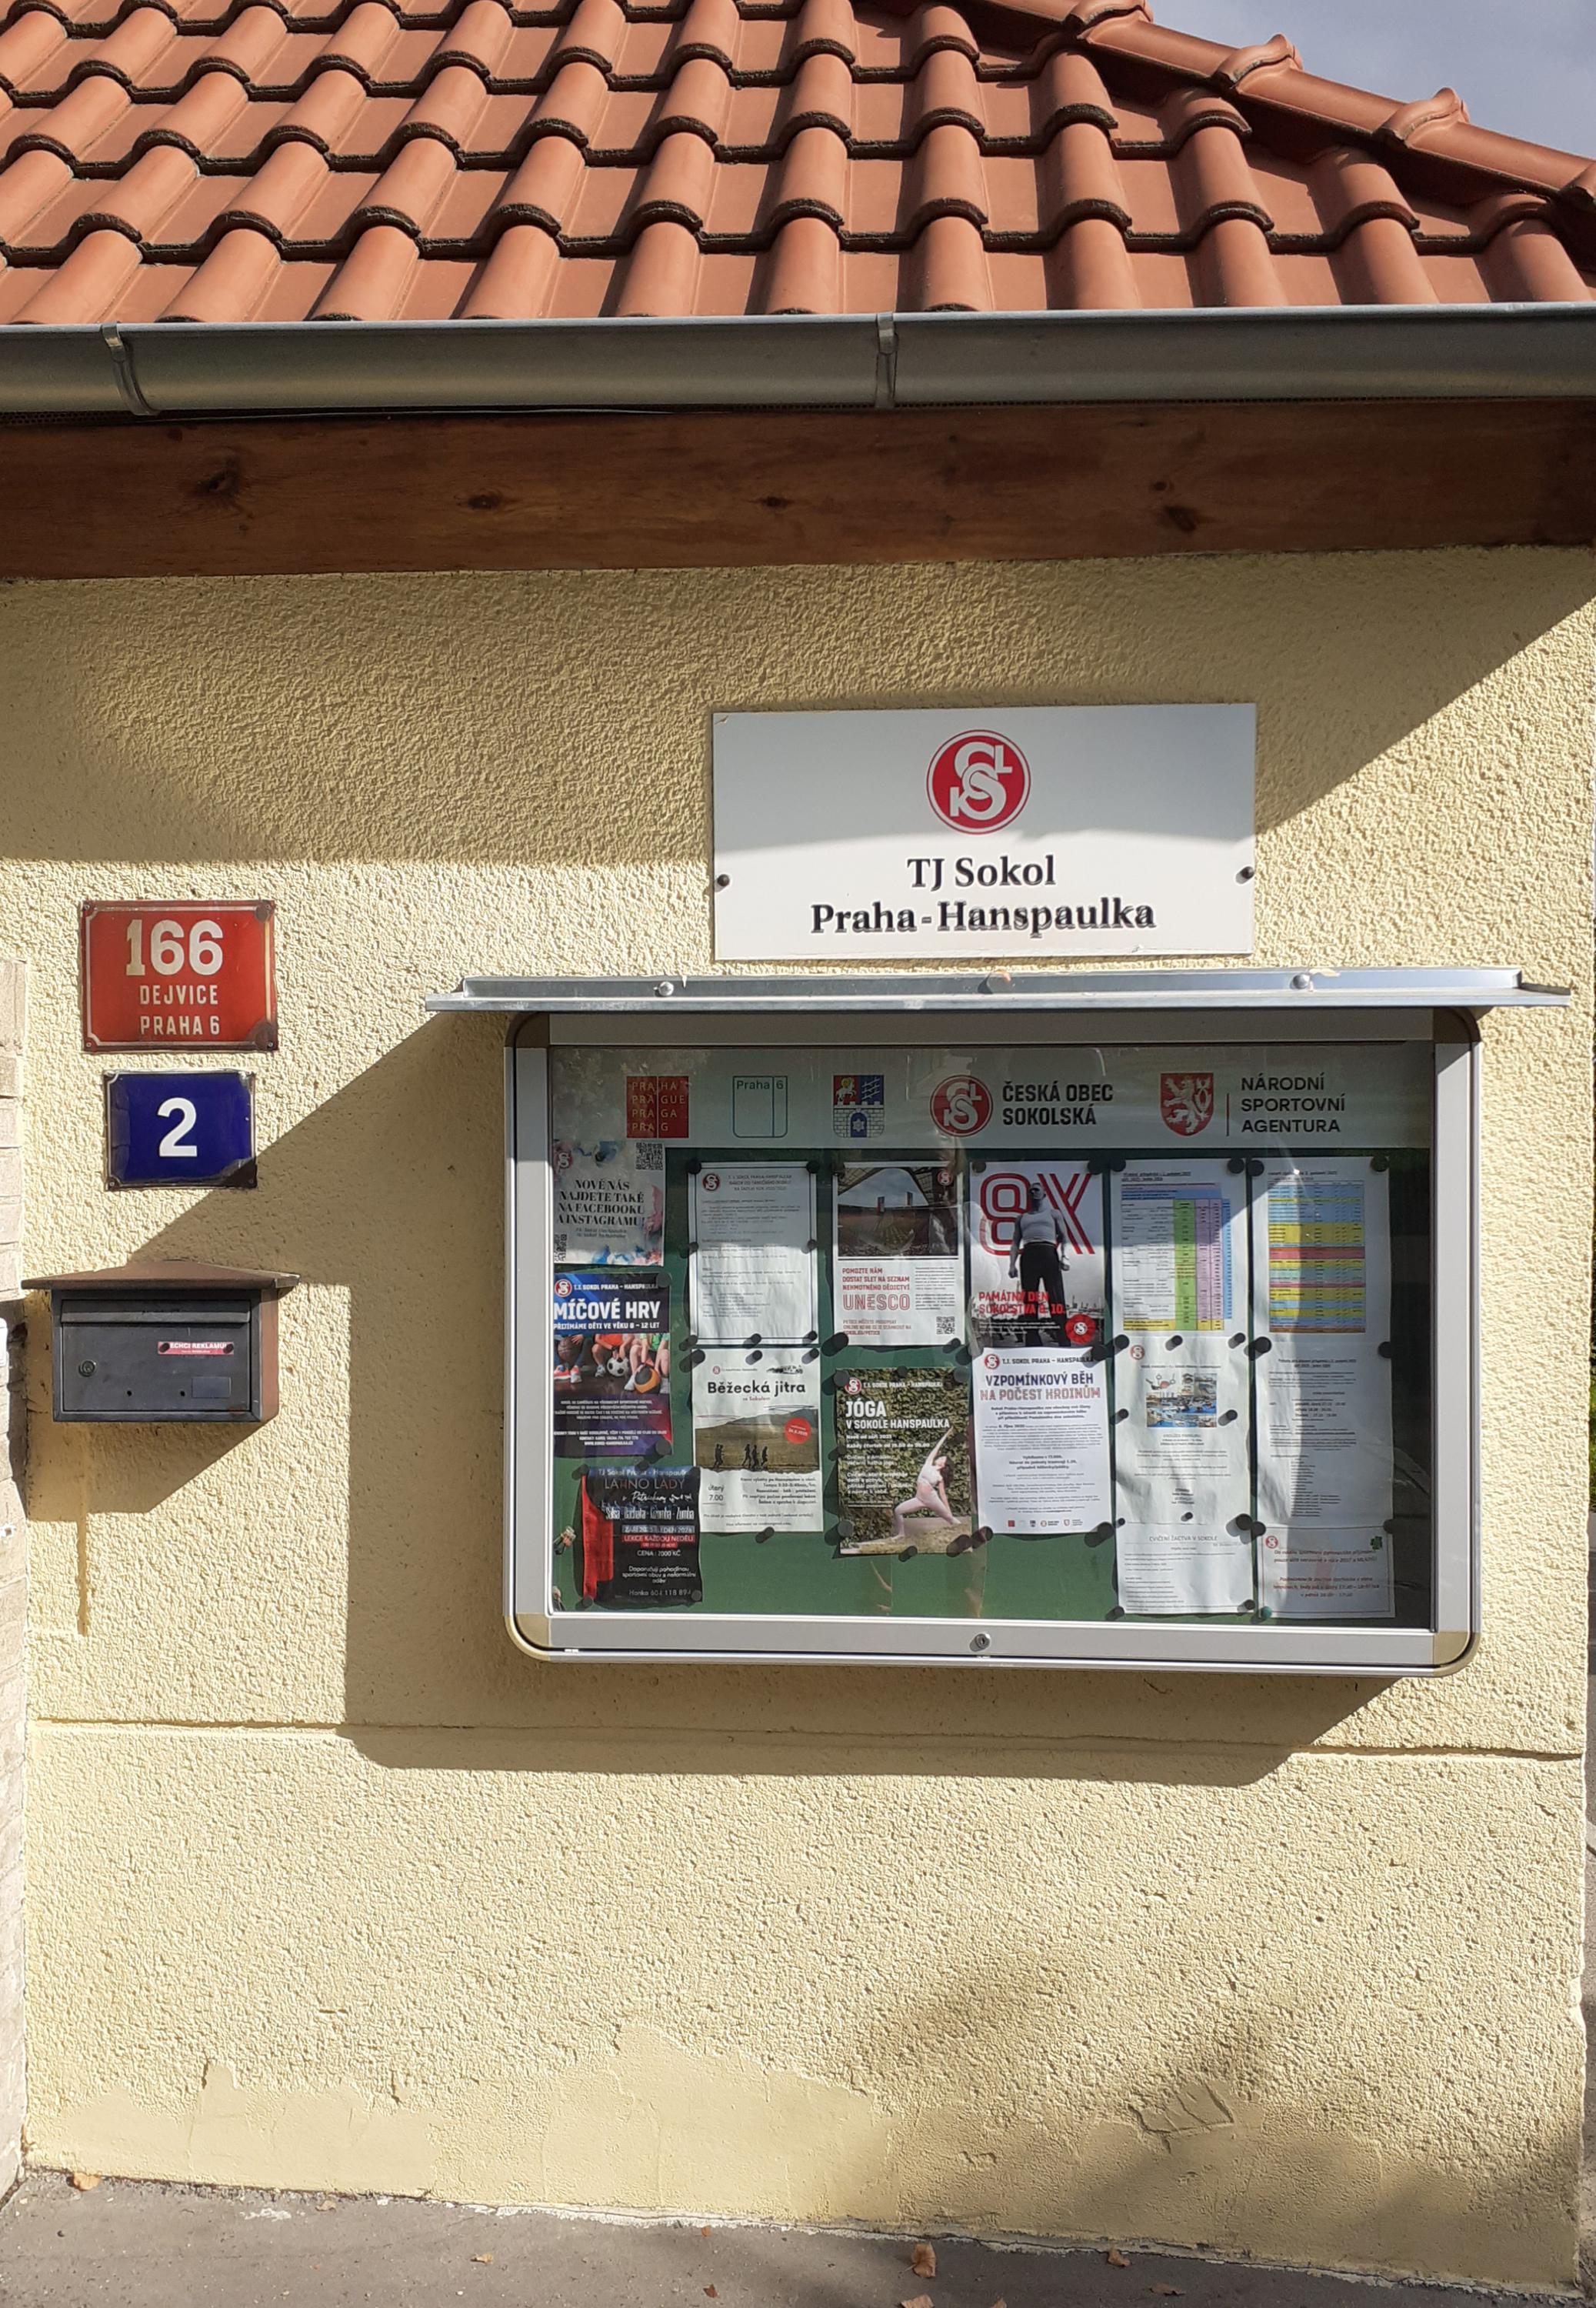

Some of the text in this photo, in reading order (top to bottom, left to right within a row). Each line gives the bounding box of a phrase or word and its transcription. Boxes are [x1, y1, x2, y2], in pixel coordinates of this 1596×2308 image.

[907, 855, 1056, 892] TJ Sokol
[125, 919, 223, 976] 166
[140, 985, 218, 1005] DEJVICE
[140, 1016, 220, 1036] PRAHA 6
[736, 1080, 784, 1089] Praha 6
[1241, 1072, 1324, 1091] NÁRODNÍ
[1002, 1079, 1113, 1102] ČESKÁ OBEC
[1241, 1093, 1345, 1112] SPORTOVNÍ
[1002, 1103, 1097, 1126] SOKOLSKÁ
[157, 1097, 198, 1157] 2
[1241, 1119, 1341, 1133] AGENTURA
[608, 1179, 630, 1190] NÁS
[560, 1191, 645, 1203] NAJDETE TAKÉ
[558, 1202, 645, 1215] NA FACEBOOKU
[558, 1214, 565, 1224] A
[843, 1293, 911, 1310] UNESCO
[1028, 1292, 1049, 1302] DEN
[554, 1297, 661, 1320] MÍČOVÉ HRY
[986, 1372, 1094, 1386] VZPOMÍNKOVÝ BĚH
[707, 1380, 806, 1397] Běžecká jitra
[980, 1386, 1101, 1401] NA POČEST HRDINŮM
[845, 1398, 887, 1418] JÓGA
[847, 1419, 951, 1429] V SOKOLE HANSPAULKA
[655, 1476, 685, 1489] LADY
[709, 1493, 724, 1502] 7.00
